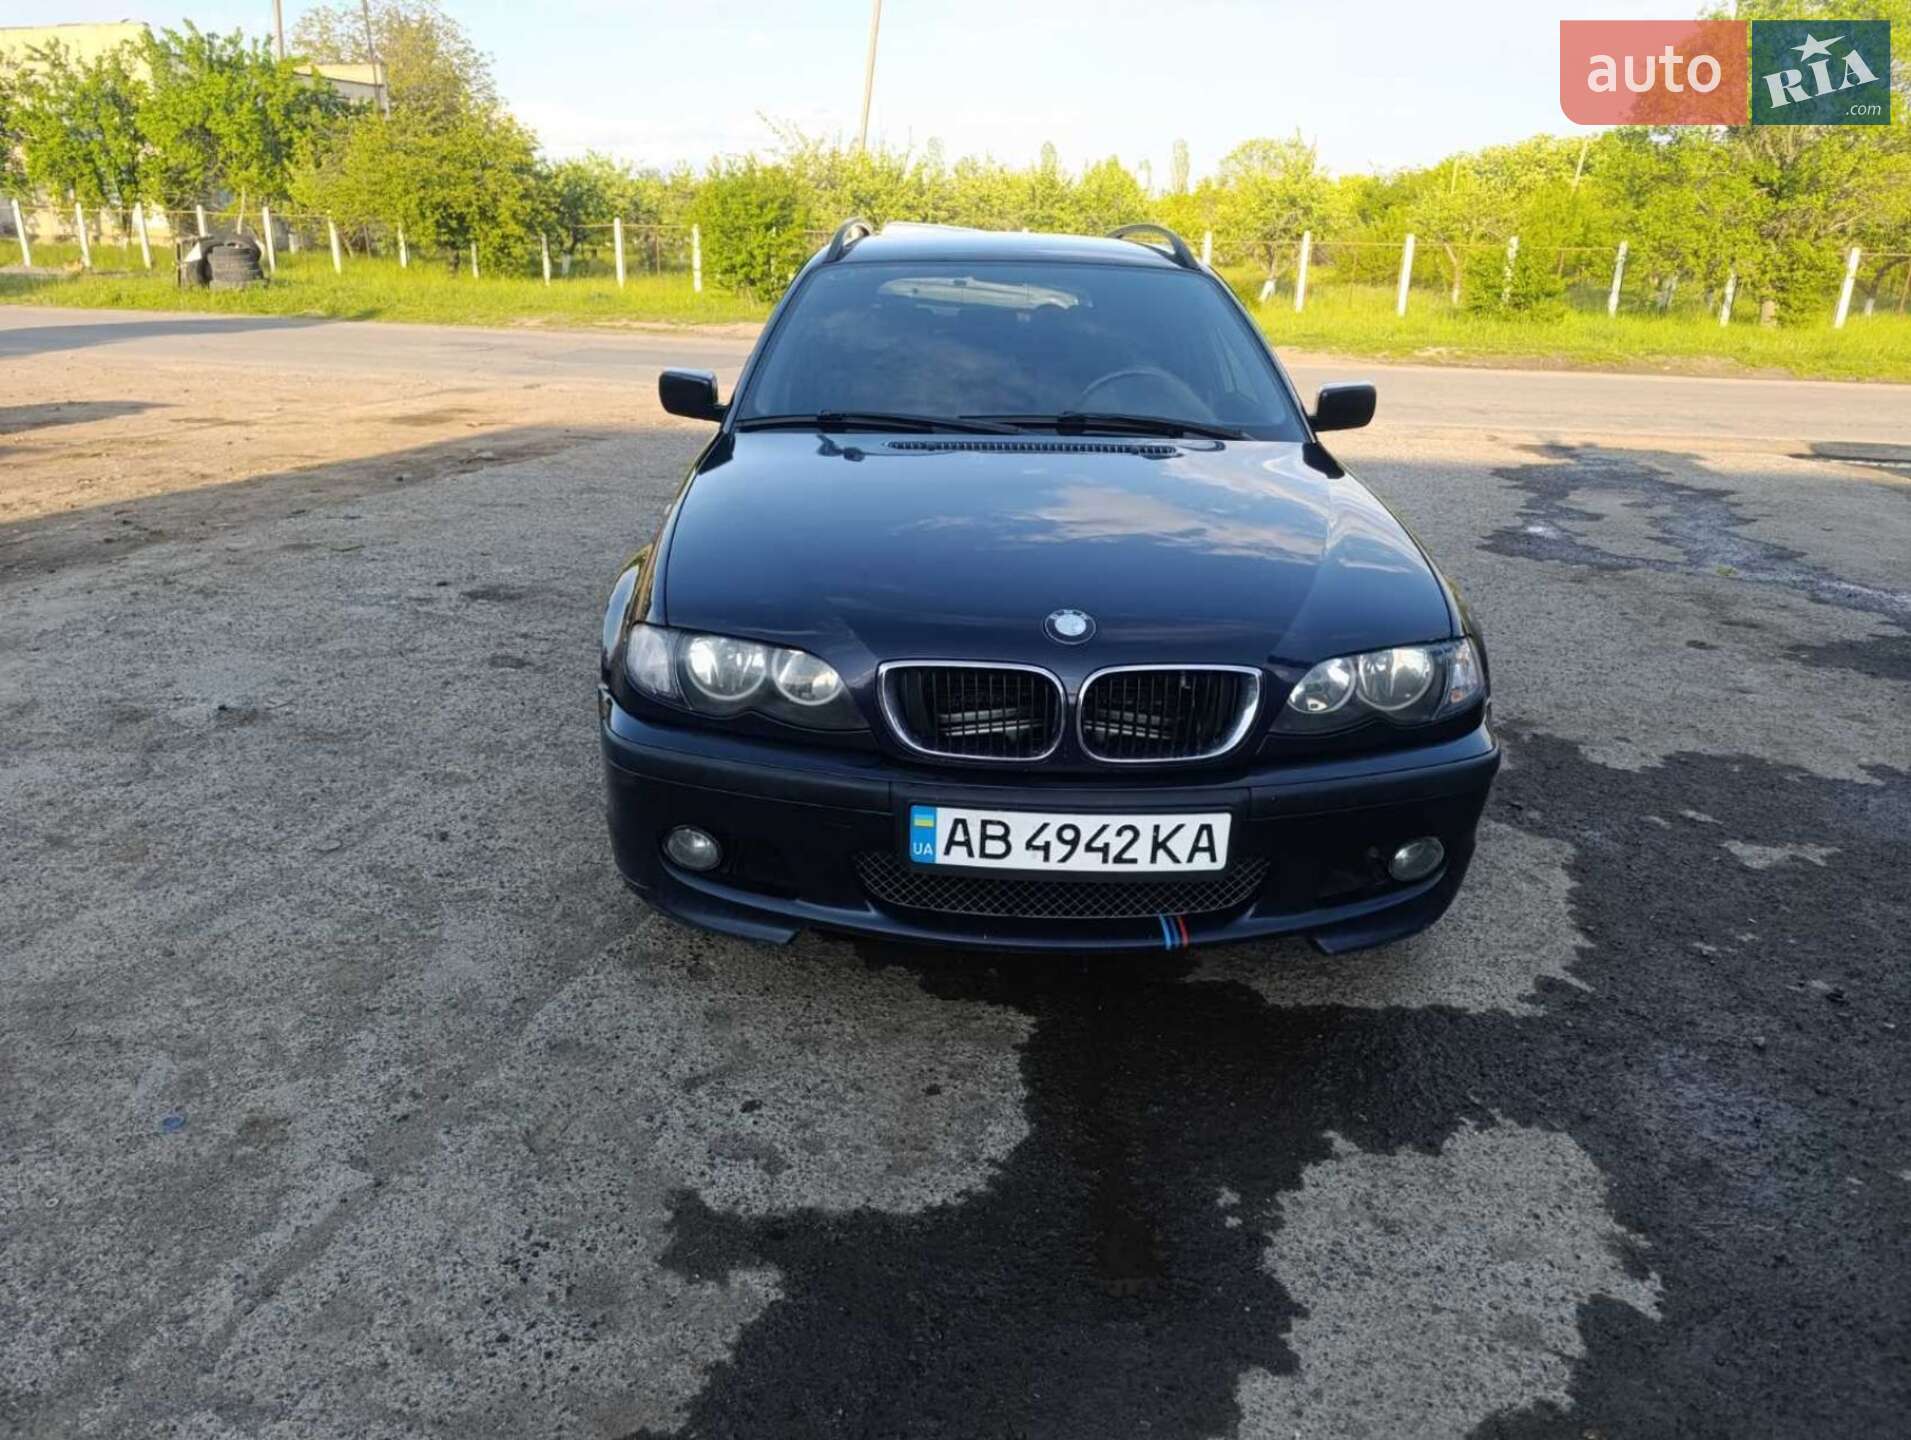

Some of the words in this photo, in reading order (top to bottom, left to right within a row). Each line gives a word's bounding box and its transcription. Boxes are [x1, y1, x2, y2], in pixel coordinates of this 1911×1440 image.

[913, 843, 933, 855] UA
[943, 817, 1012, 860] AB
[1025, 822, 1141, 865] 4942
[1150, 823, 1218, 865] KA
